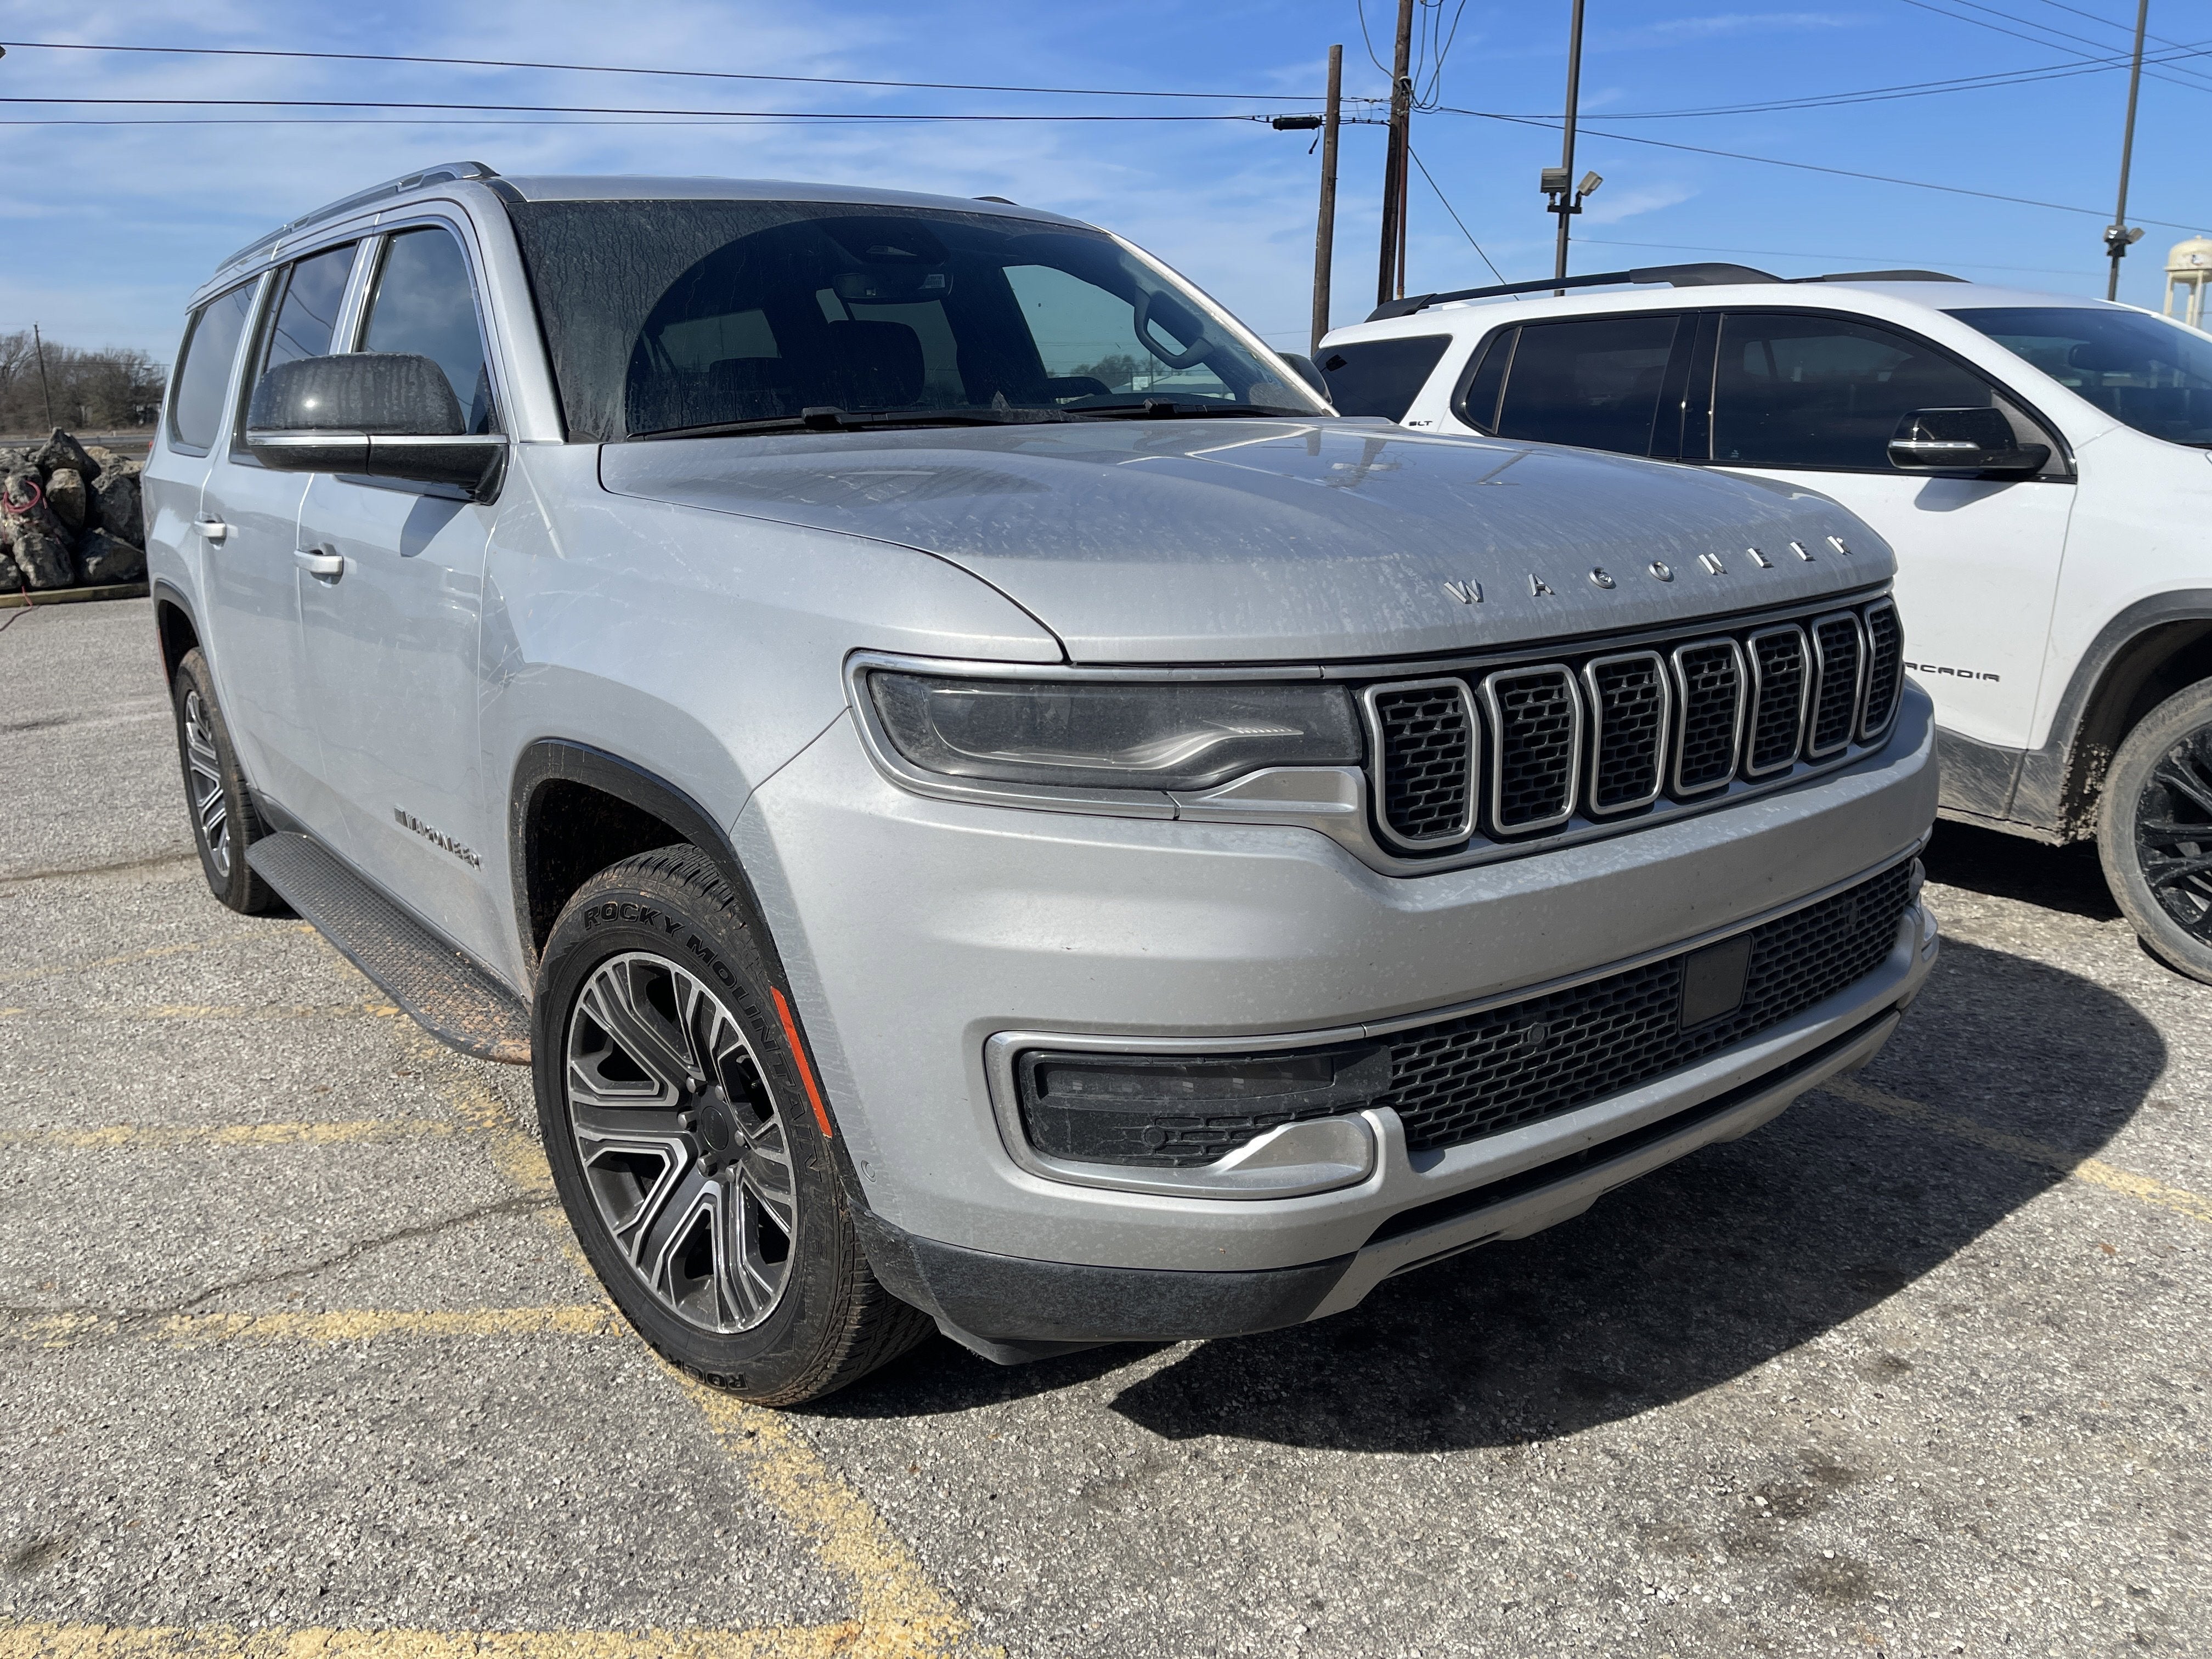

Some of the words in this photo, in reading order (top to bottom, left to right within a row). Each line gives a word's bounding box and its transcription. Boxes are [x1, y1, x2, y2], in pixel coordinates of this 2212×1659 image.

[1444, 535, 1851, 605] WAGONEER
[1904, 662, 2000, 682] ACADIA
[583, 901, 685, 938] ROCKY
